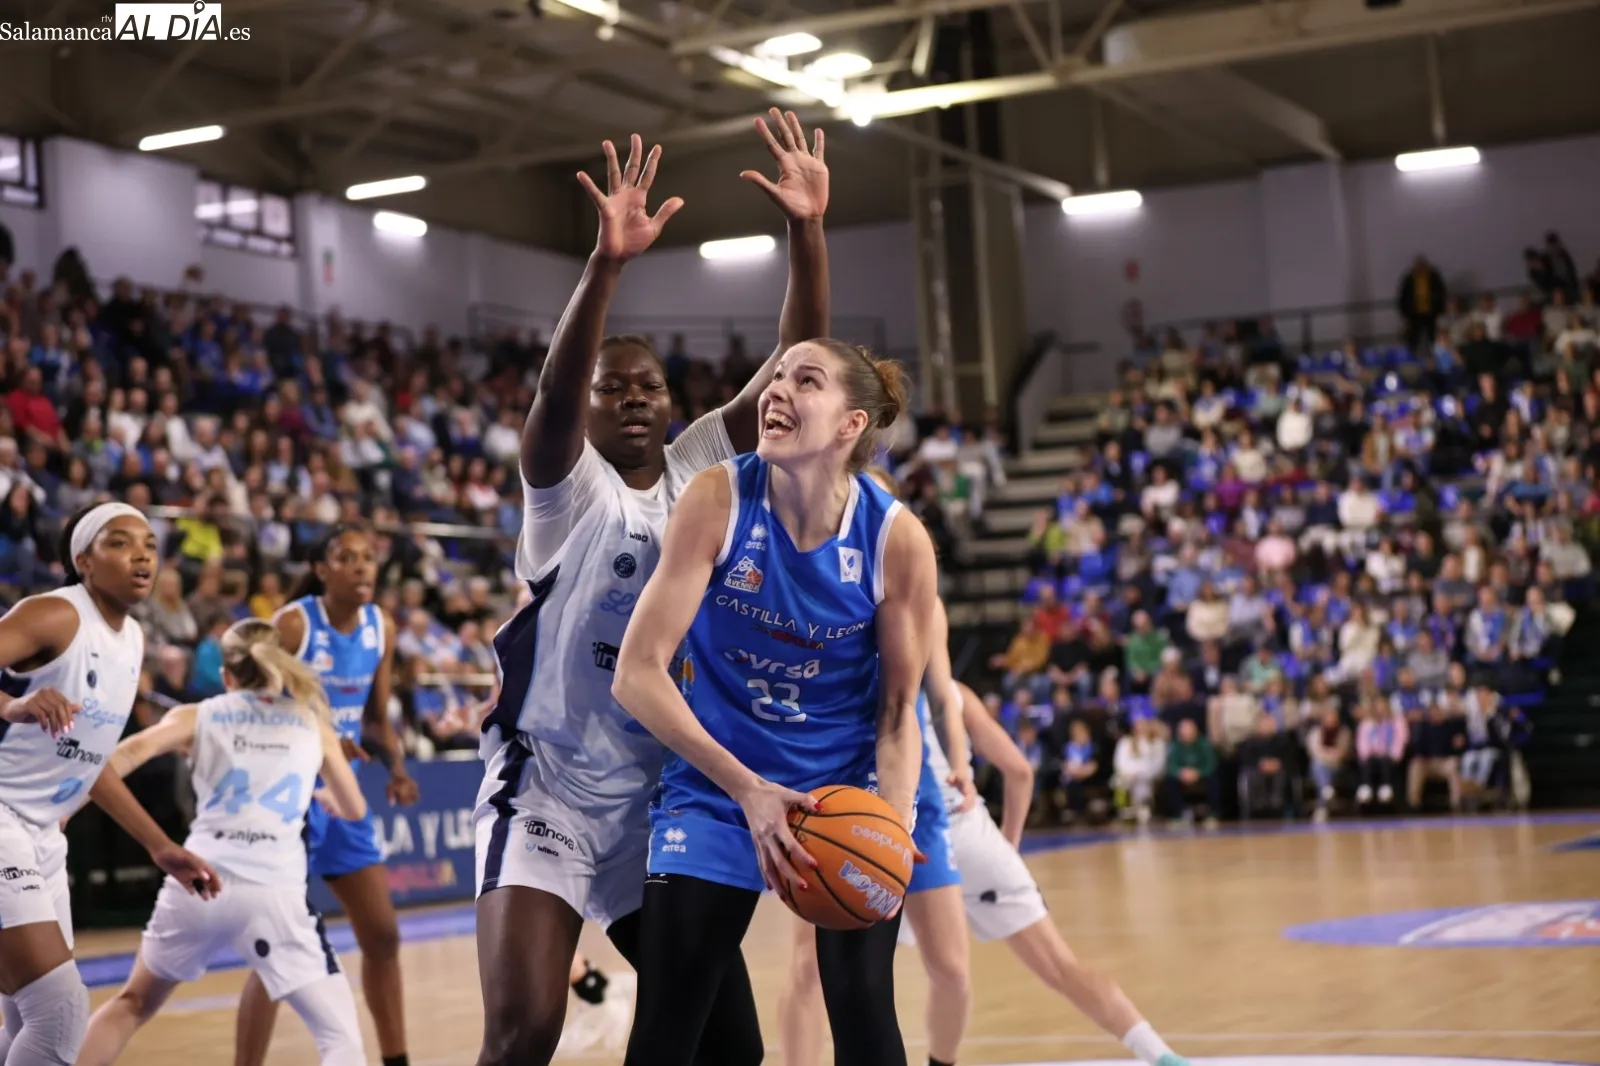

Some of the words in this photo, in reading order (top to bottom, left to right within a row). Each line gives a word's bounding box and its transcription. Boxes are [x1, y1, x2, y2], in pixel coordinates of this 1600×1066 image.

[716, 595, 797, 631] CASTILLA
[808, 622, 820, 639] Y
[825, 620, 866, 639] LEON
[746, 678, 807, 723] 23
[206, 768, 303, 824] 44
[418, 810, 440, 859] Y
